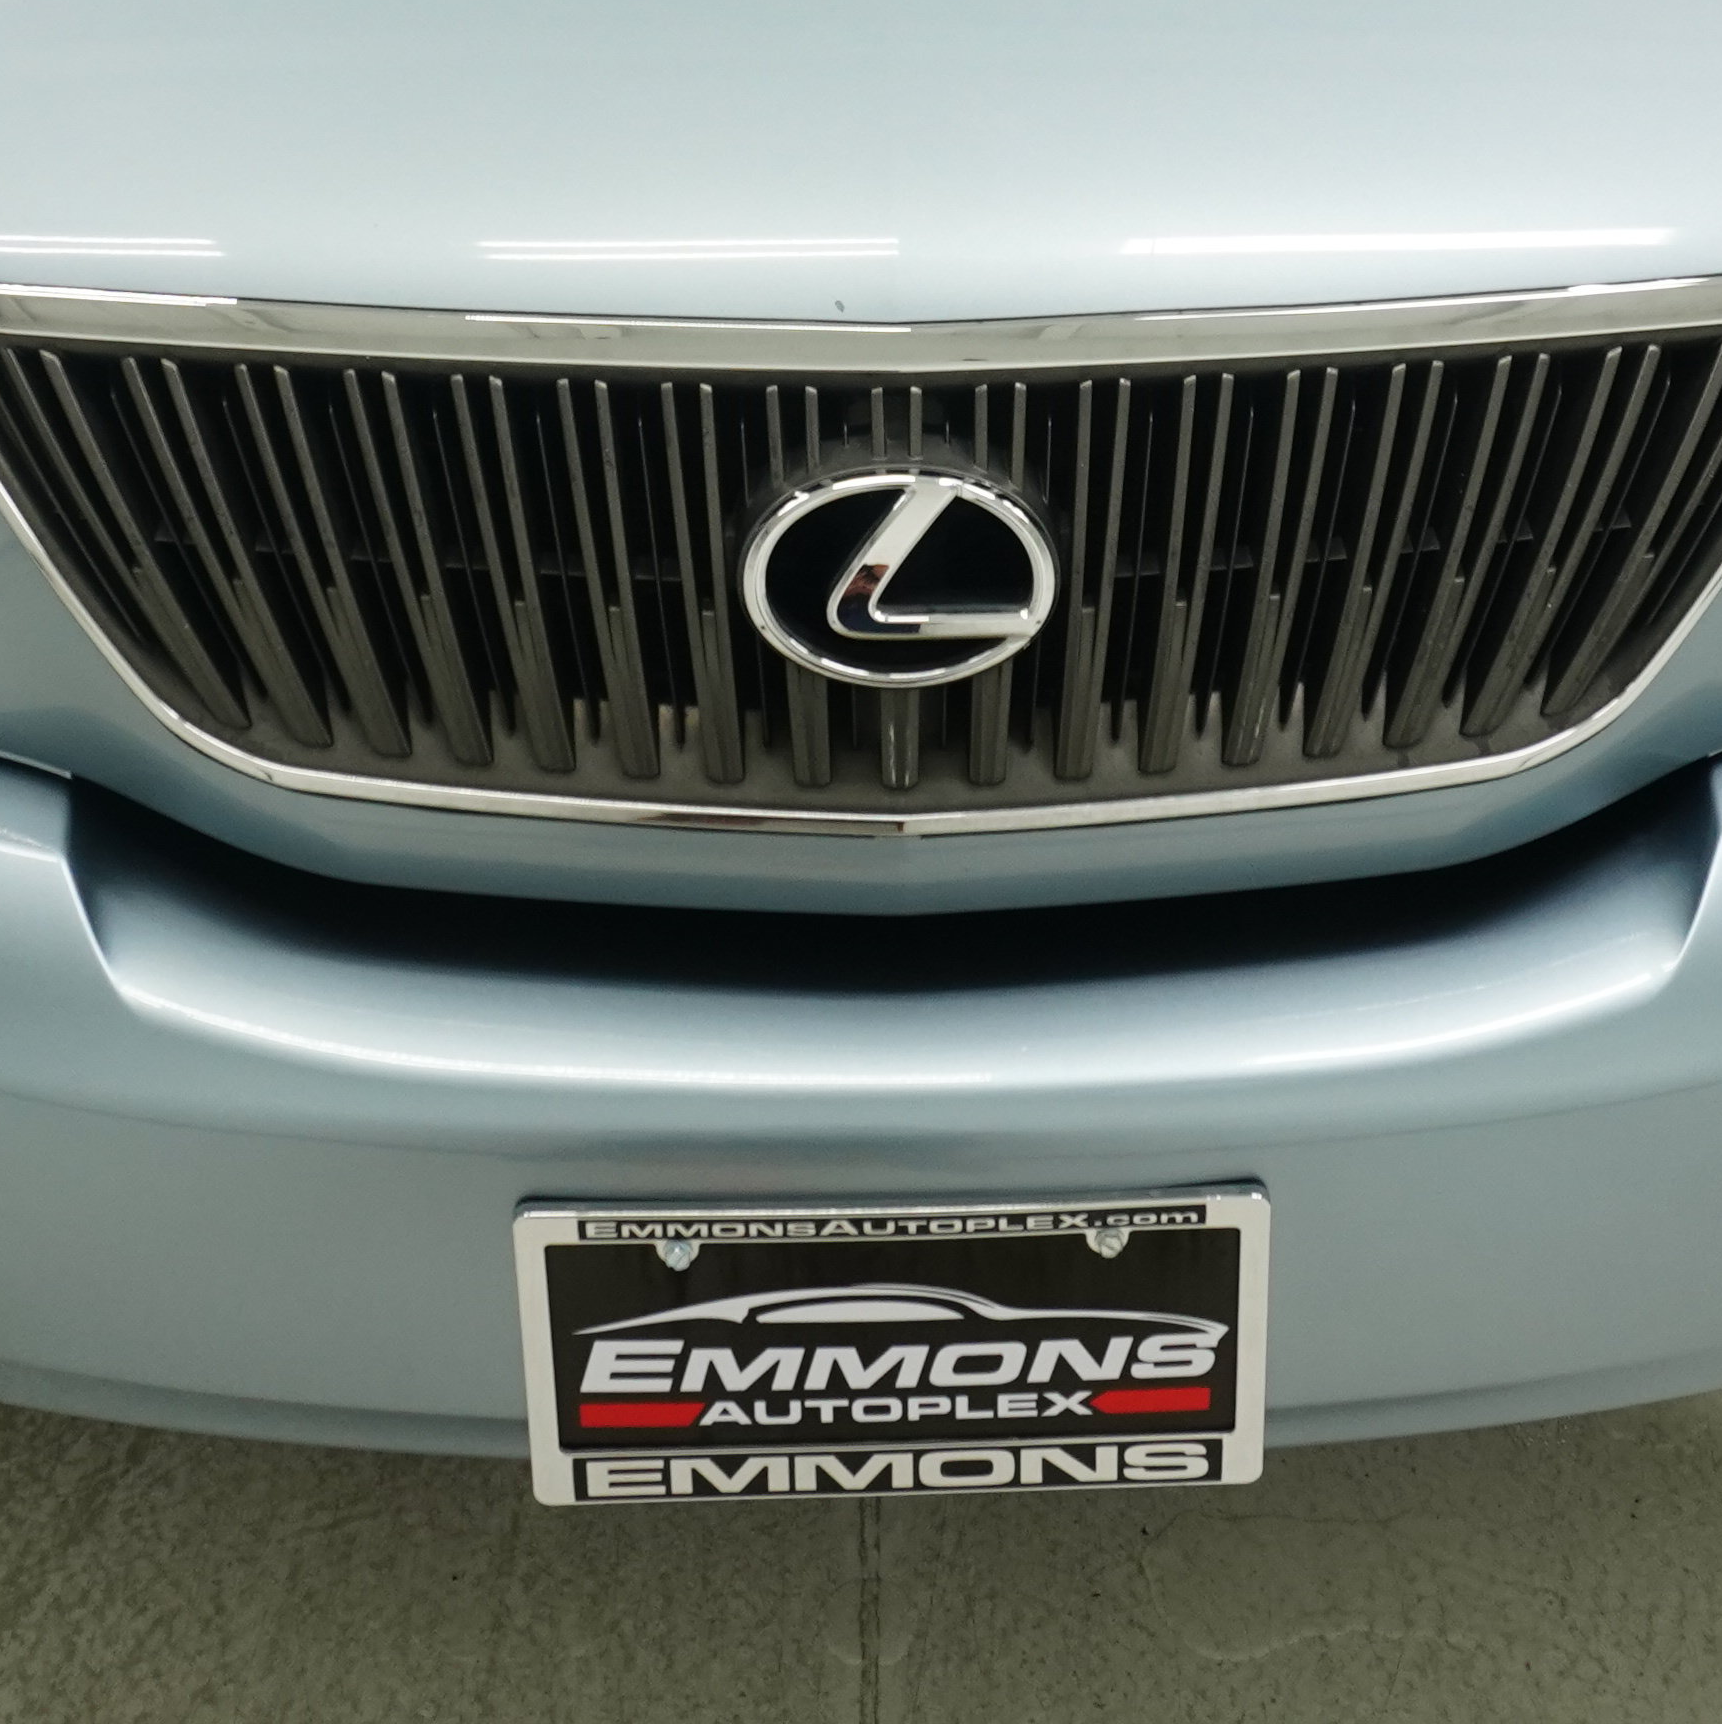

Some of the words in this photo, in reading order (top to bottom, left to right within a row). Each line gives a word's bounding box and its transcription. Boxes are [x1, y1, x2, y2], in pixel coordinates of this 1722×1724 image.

[581, 1332, 1219, 1393] EMMONS
[700, 1391, 1092, 1426] AUTOPLEX
[586, 1443, 1210, 1496] EMMONS
